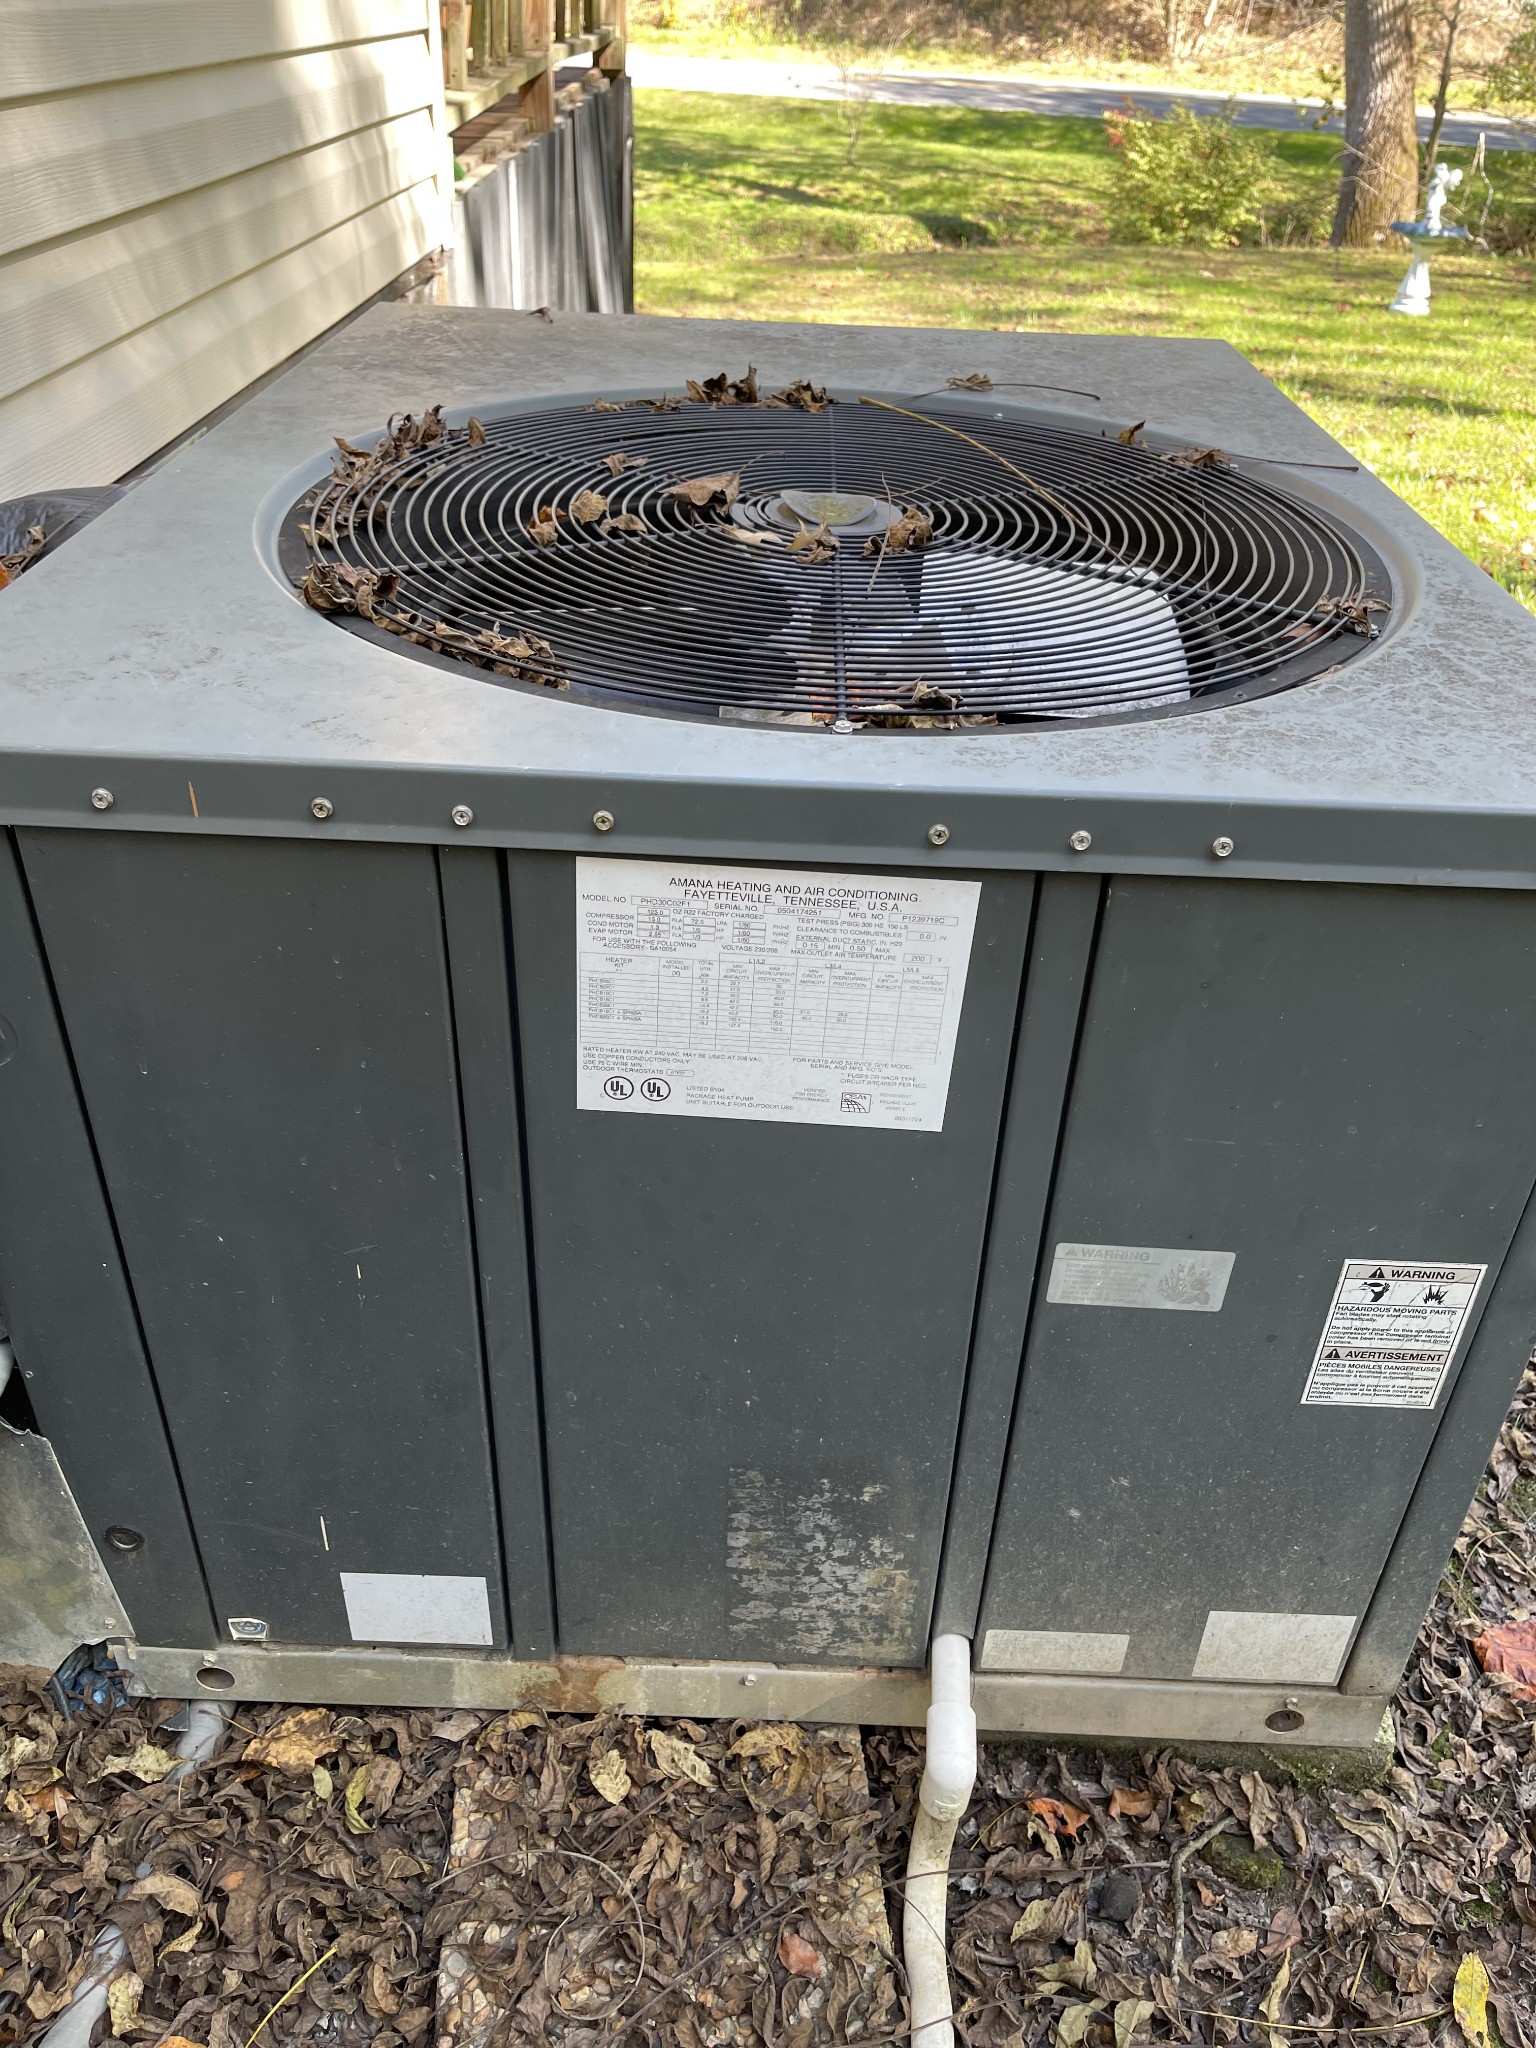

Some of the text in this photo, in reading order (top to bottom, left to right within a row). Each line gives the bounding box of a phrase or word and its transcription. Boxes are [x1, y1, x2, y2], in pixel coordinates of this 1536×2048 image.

[670, 878, 712, 888] AMANA
[718, 880, 770, 893] HEATING
[775, 885, 800, 895] AND
[804, 887, 824, 897] AIR
[582, 894, 611, 902] MODEL
[714, 903, 742, 911] SERIAL
[684, 890, 902, 912] FAYETTEVILLE, TENNESSEE, U.S.A.
[586, 912, 634, 920] COMPRESSOR
[797, 926, 837, 934] CLEARANCE
[850, 929, 902, 937] COMBUSTIBLES
[848, 953, 897, 961] TEMPERATURE
[626, 1055, 670, 1063] CONDUCTORS
[1081, 1249, 1150, 1261] WARNING
[1391, 1270, 1456, 1280] WARNING
[1345, 1350, 1443, 1362] AVERTISSEMENT
